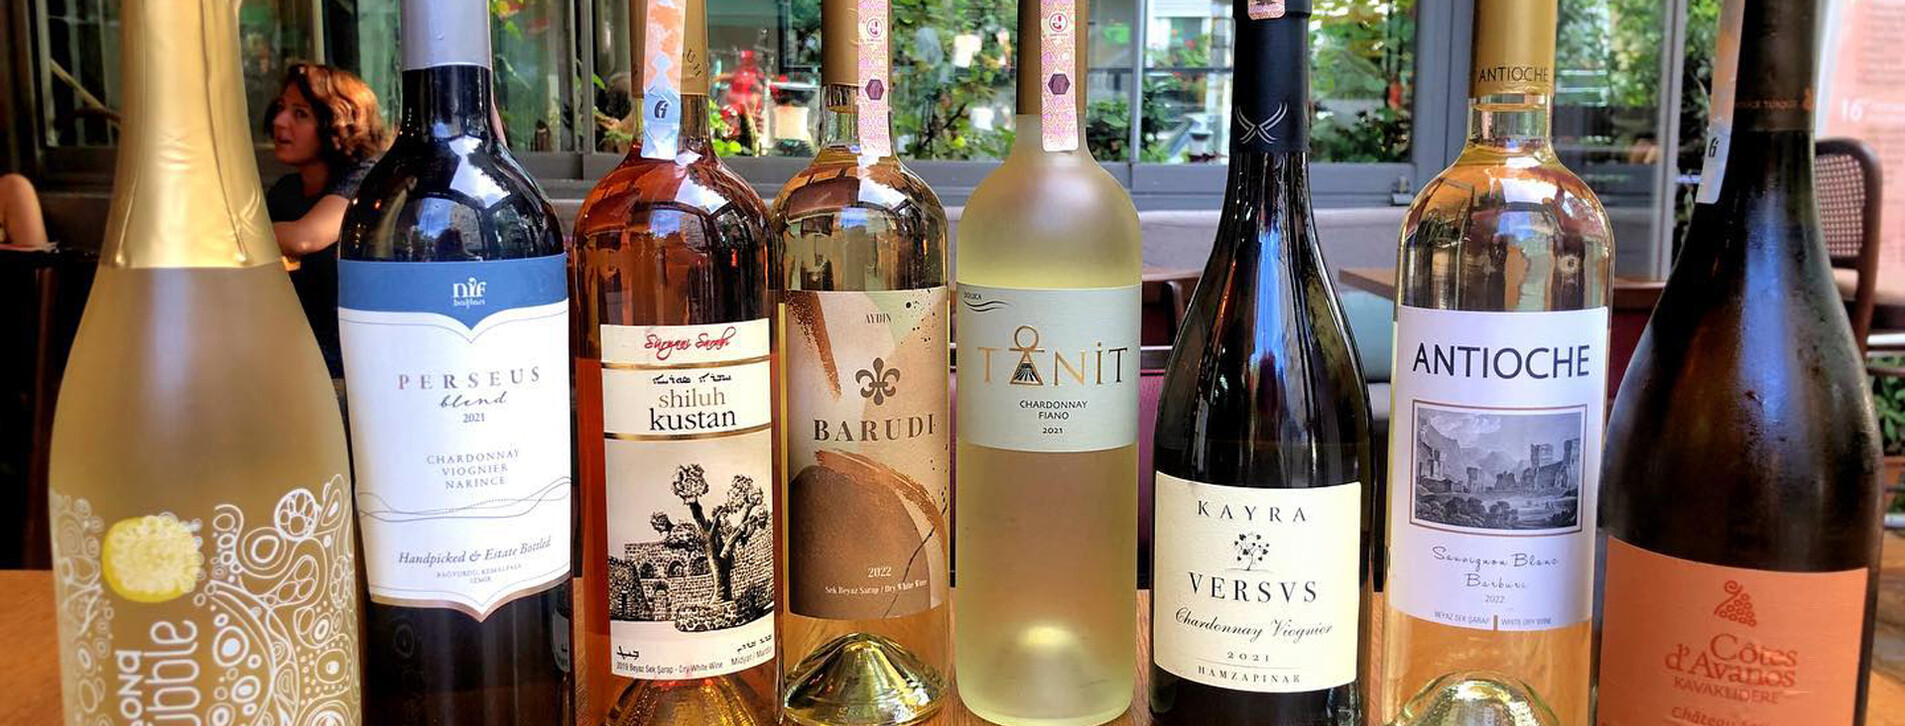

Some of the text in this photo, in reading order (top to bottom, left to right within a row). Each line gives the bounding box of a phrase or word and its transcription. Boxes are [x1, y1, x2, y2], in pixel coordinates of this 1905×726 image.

[1478, 66, 1549, 83] ANTIOCHE
[452, 276, 487, 298] nif
[864, 312, 892, 325] AYDIN
[1412, 342, 1591, 379] ANTIOCHE
[397, 366, 541, 390] PERSEUS
[440, 390, 508, 409] blend
[658, 386, 726, 409] shiluh
[1019, 399, 1089, 410] CHARDONNAY
[462, 412, 486, 424] 2021
[649, 408, 737, 431] kustan
[1038, 411, 1070, 420] FIANO
[813, 413, 934, 442] BARUDI
[1042, 427, 1063, 435] 2021
[426, 448, 520, 465] CHARDONNAY
[441, 463, 509, 477] VIOGNIER
[445, 476, 506, 490] NARINCE
[1197, 500, 1307, 523] KAYRA
[398, 535, 552, 568] Handpicked & Estate Bottled
[1432, 545, 1559, 572] Sauvignon Blanc
[867, 566, 892, 578] 2022
[1187, 571, 1318, 604] VERSVS
[1485, 594, 1505, 604] 2022
[1174, 606, 1334, 643] Chardonnay Viognier
[1226, 651, 1270, 663] 2021
[1709, 632, 1799, 668] Côtes
[1197, 665, 1301, 684] HAMZAPINAR
[1673, 676, 1779, 704] KAVAKLIDERE
